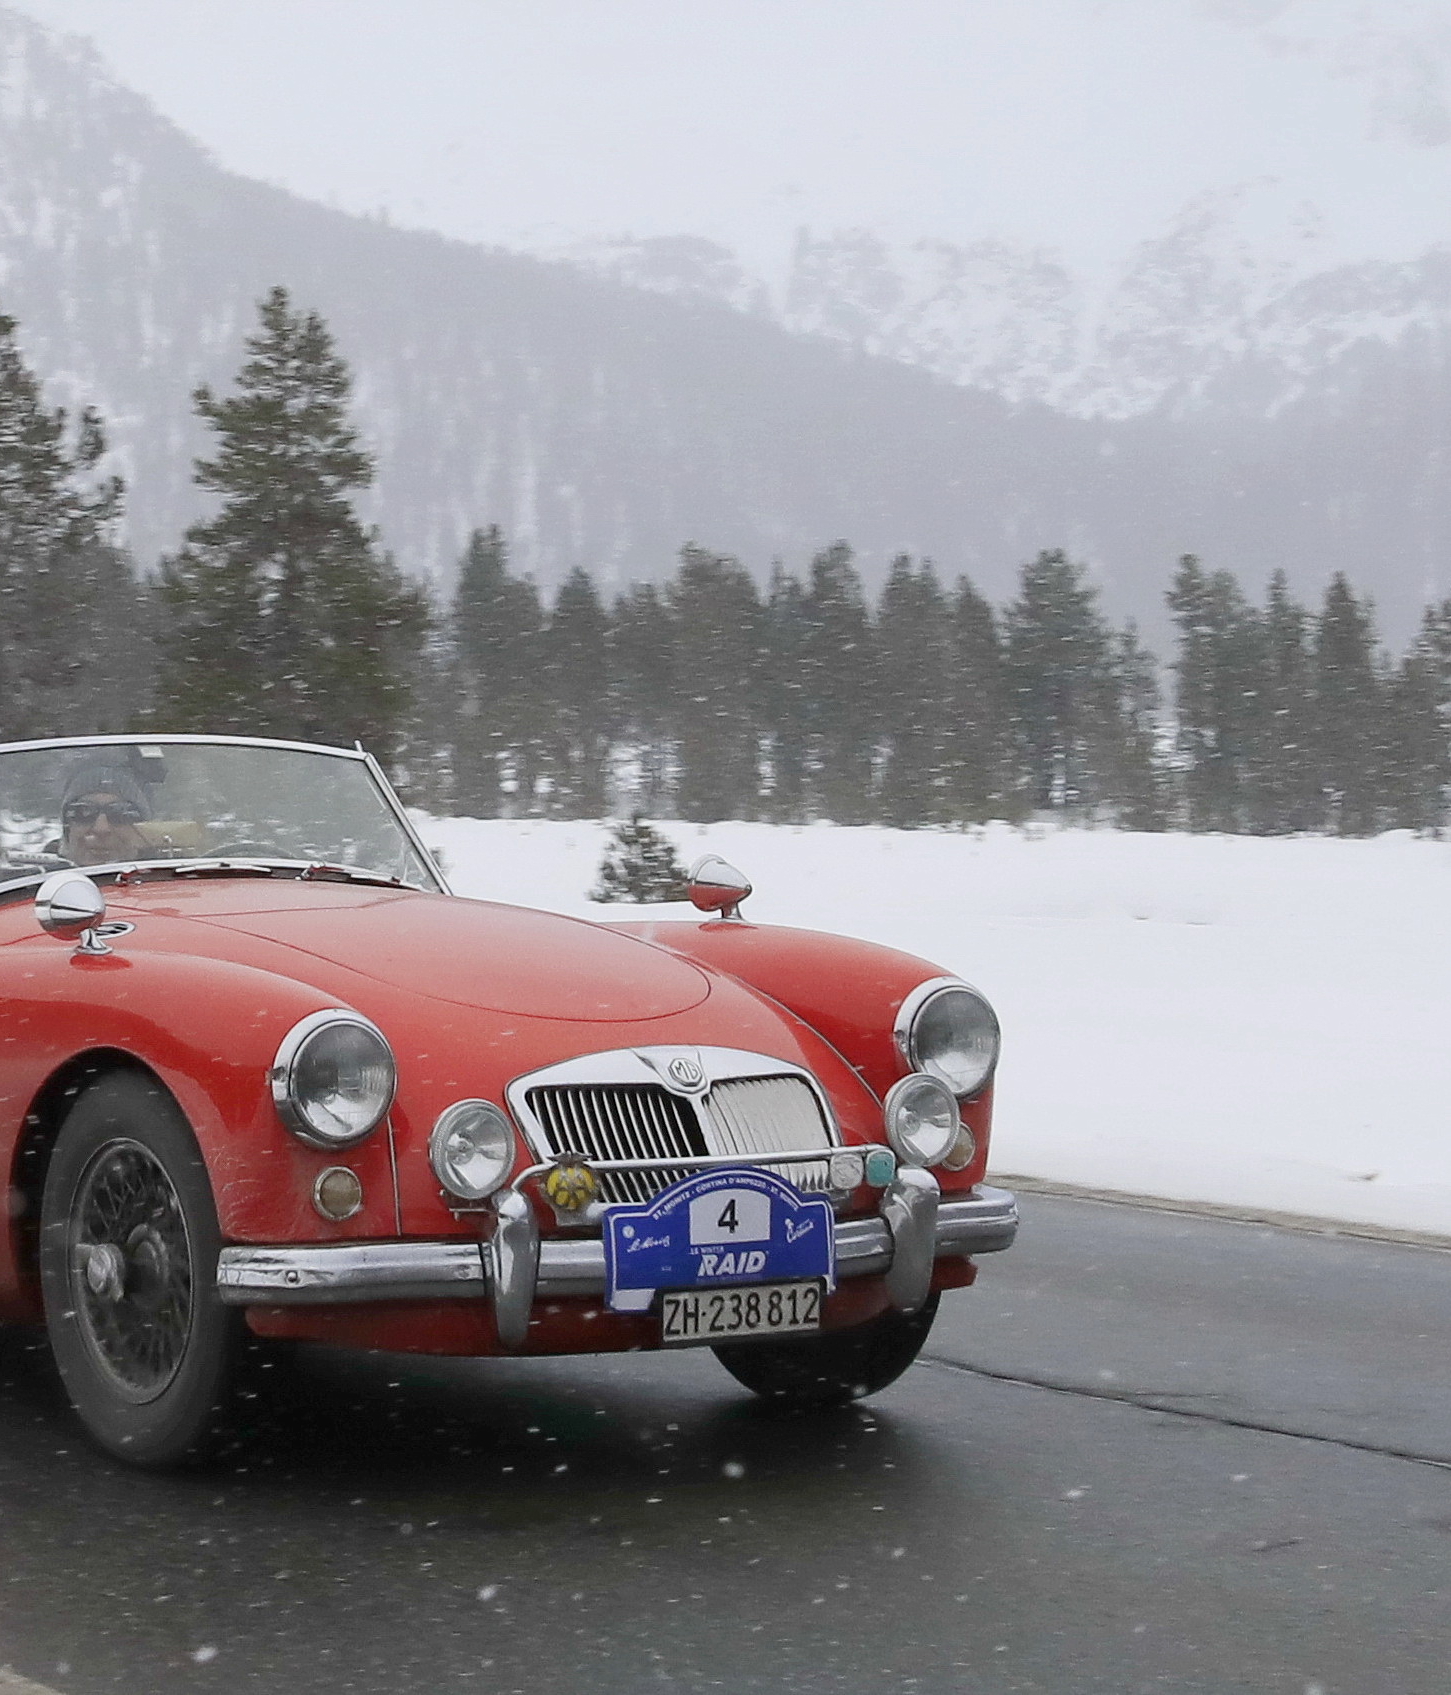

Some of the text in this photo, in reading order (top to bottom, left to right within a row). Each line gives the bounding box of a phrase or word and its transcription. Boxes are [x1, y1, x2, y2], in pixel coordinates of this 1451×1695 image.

[674, 1060, 699, 1081] MG
[717, 1199, 739, 1234] 4
[697, 1250, 767, 1277] RAID
